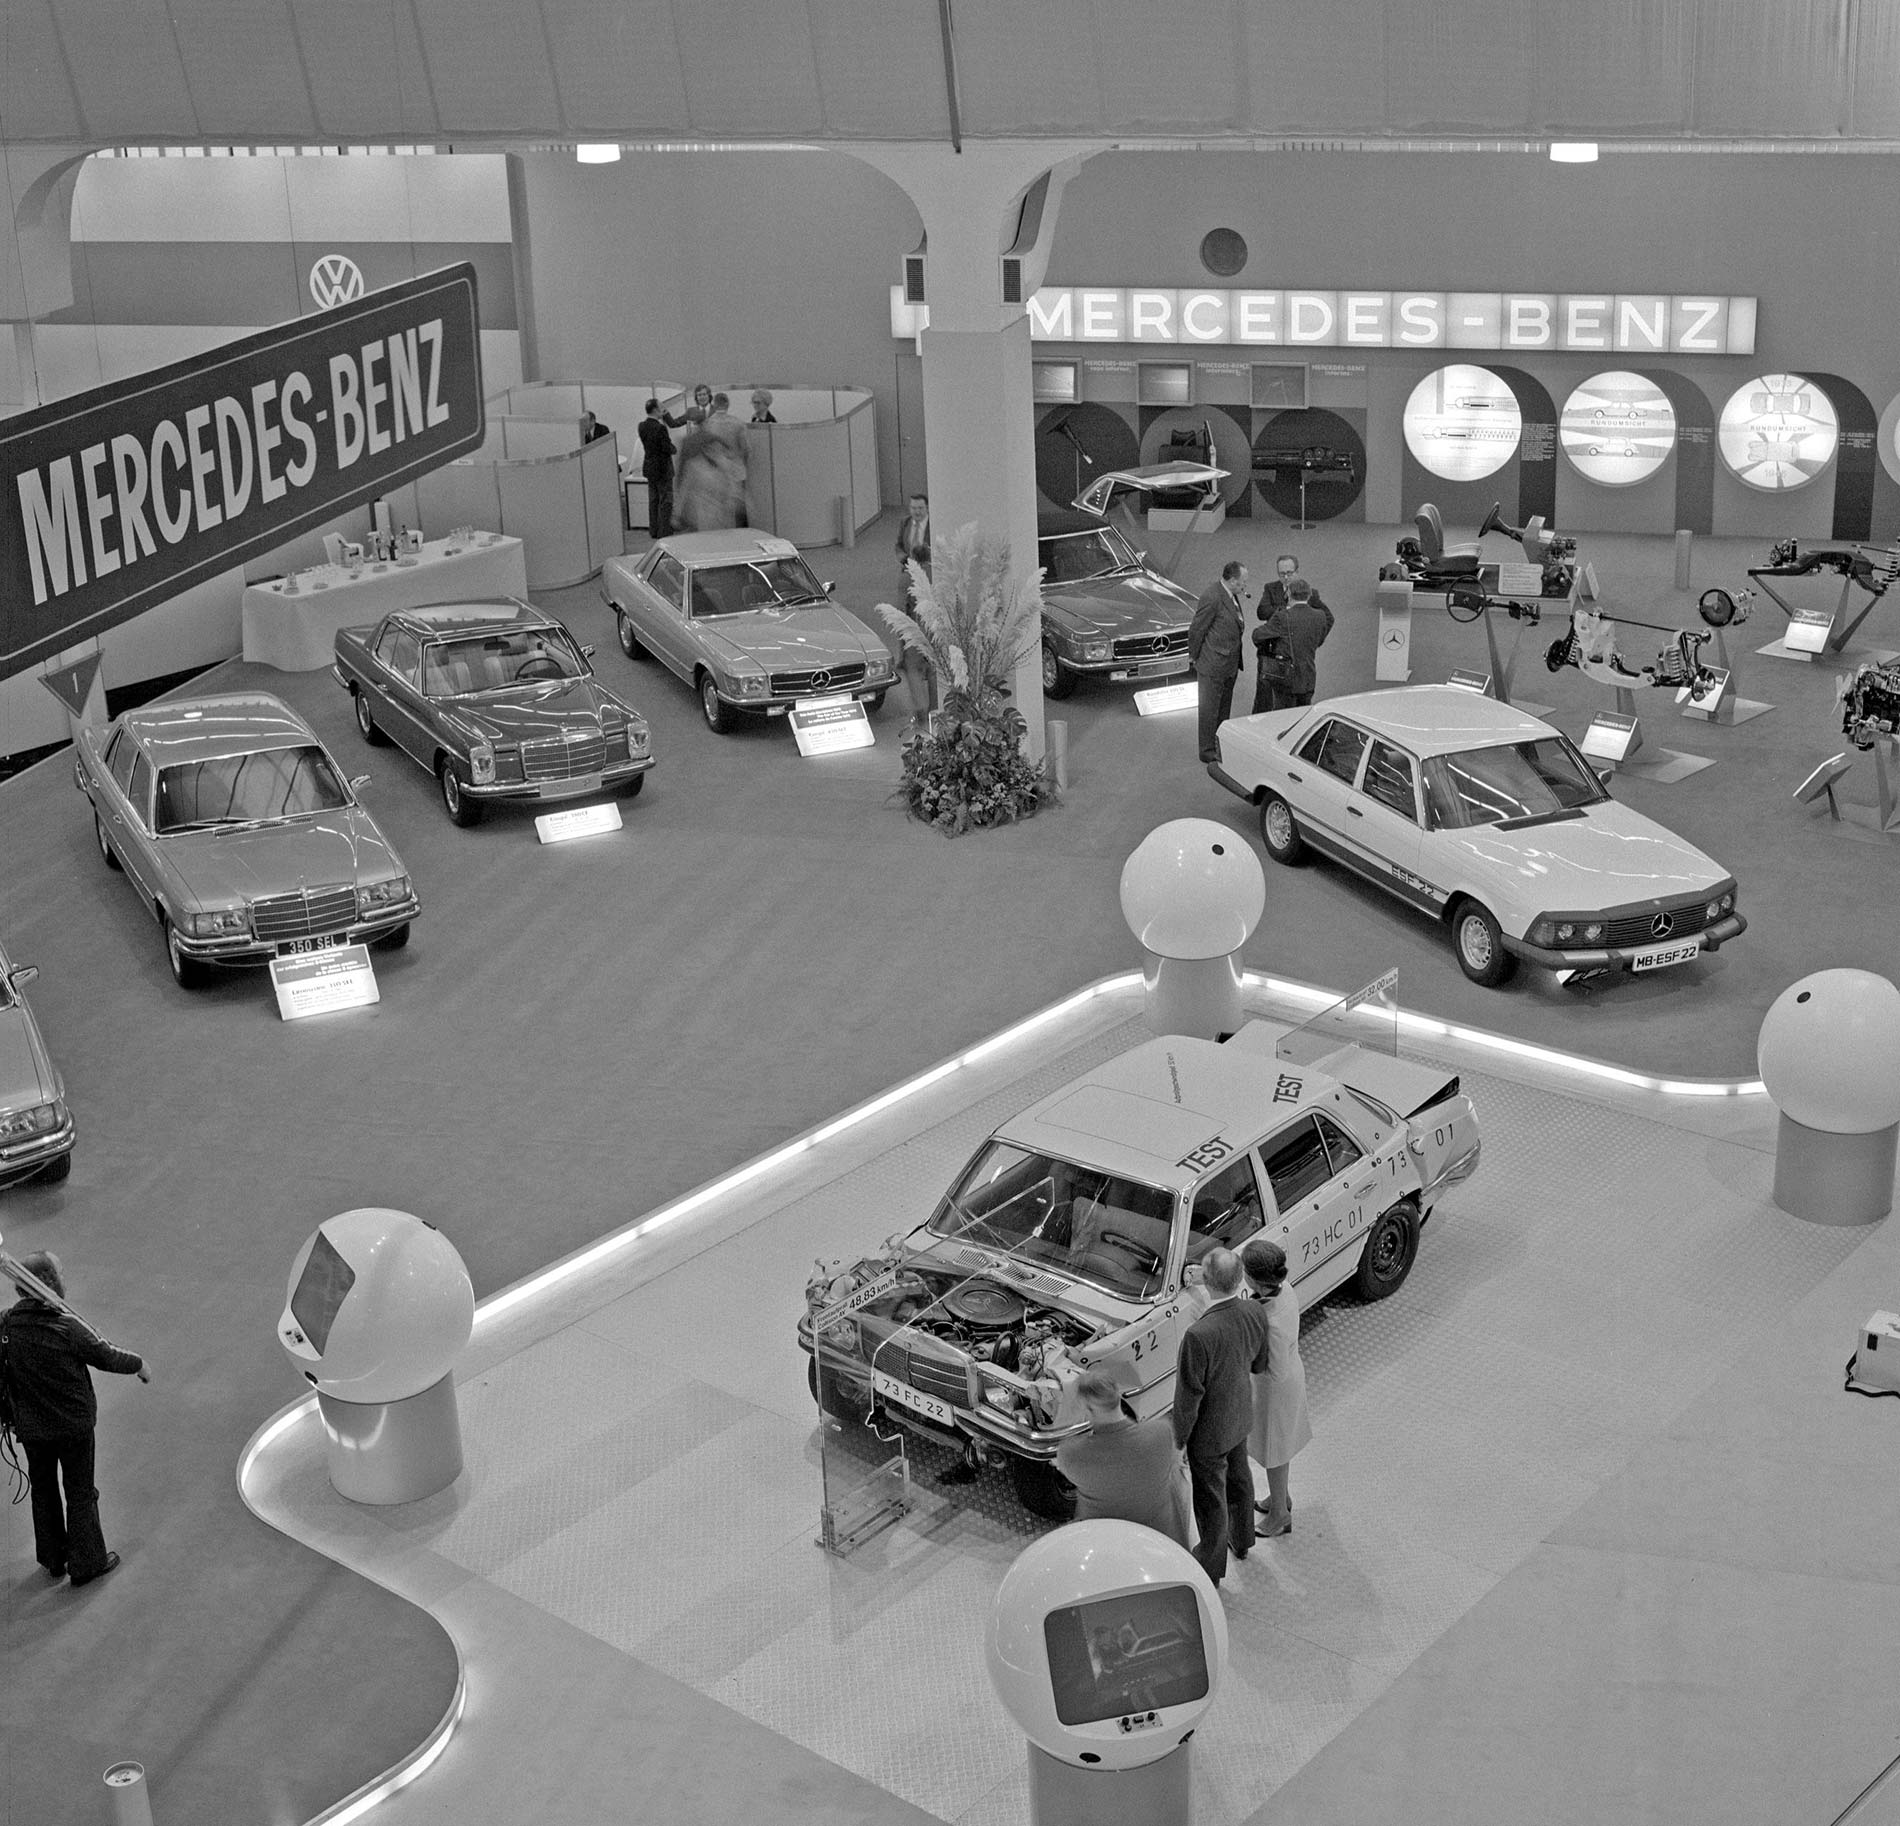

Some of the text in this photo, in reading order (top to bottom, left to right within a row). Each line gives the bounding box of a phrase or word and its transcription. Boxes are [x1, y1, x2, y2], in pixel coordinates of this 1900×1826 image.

[1026, 292, 1719, 349] MERCEDES-BENZ
[17, 318, 450, 605] MERCEDES-BENZ
[1392, 865, 1435, 898] ESF 22
[289, 935, 337, 954] 350 SEL
[1272, 1073, 1303, 1104] TEST
[1175, 1136, 1234, 1174] TEST
[1302, 1205, 1363, 1263] 73 HC 01
[849, 1278, 895, 1309] 48.83 km/h
[882, 1379, 944, 1418] 73 FC 22
